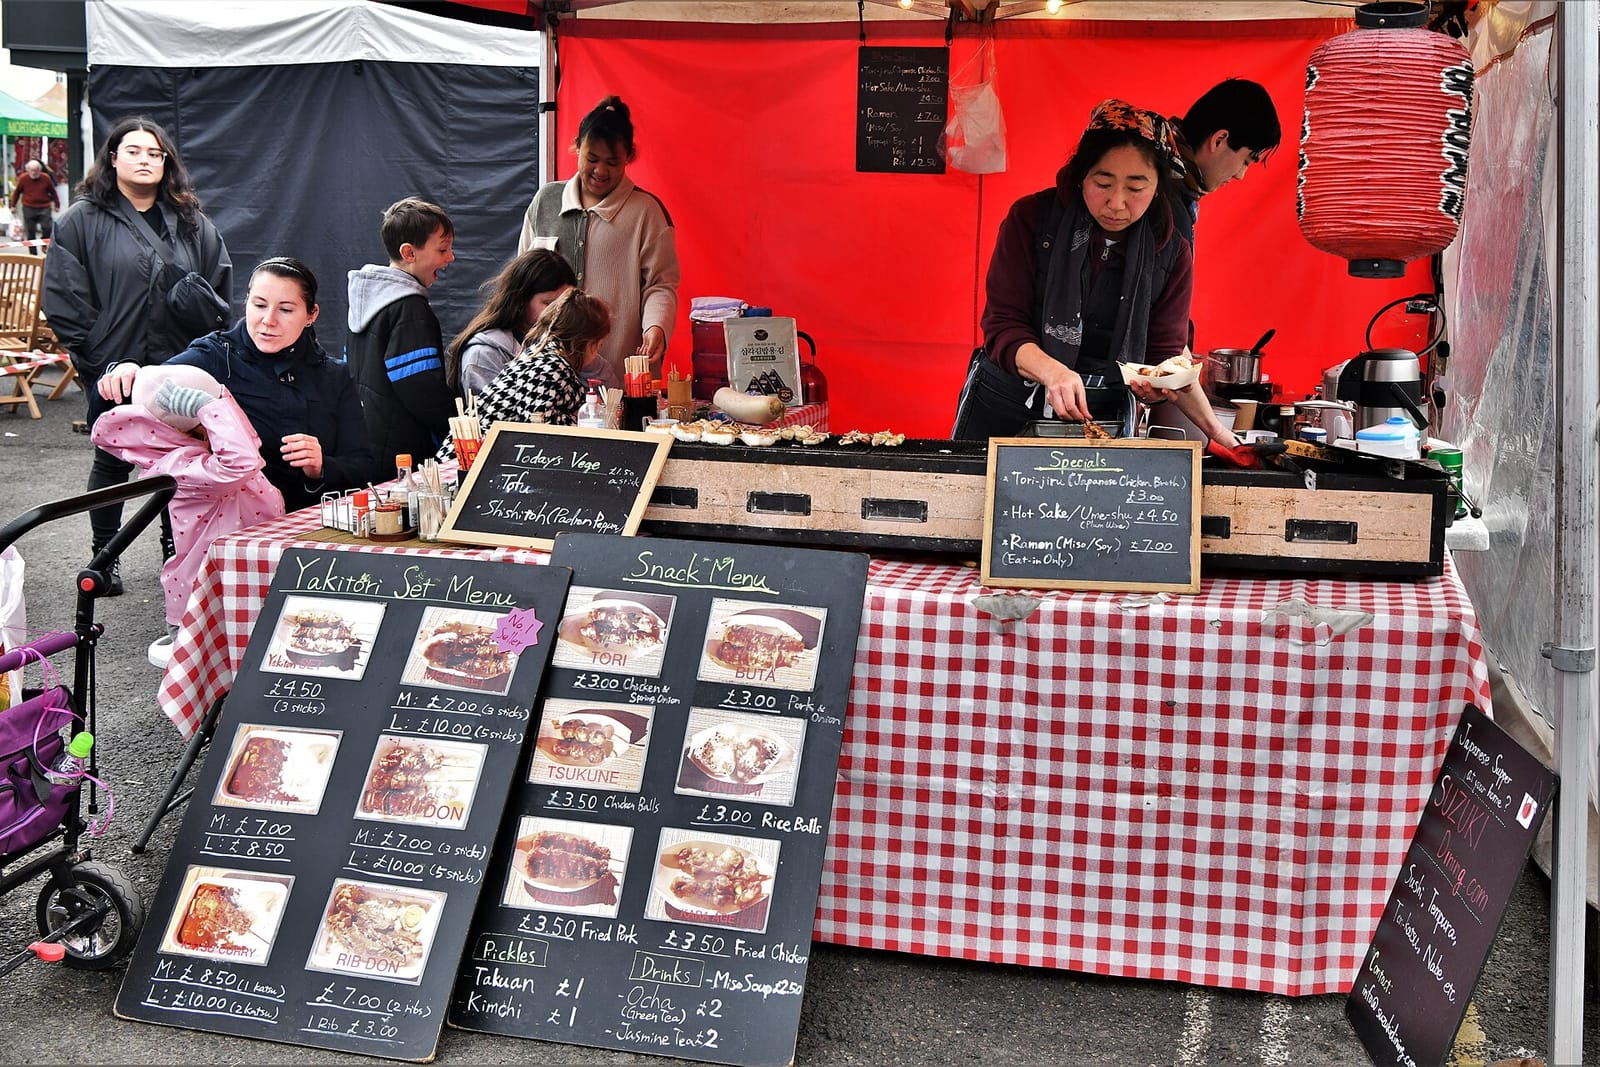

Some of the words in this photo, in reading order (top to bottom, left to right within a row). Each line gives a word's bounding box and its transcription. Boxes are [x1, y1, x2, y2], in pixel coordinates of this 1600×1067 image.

[8, 122, 49, 134] MORTGAGE
[570, 451, 601, 473] Vege
[608, 467, 635, 476] £1.50
[1050, 451, 1106, 474] Specials
[501, 471, 531, 494] Tofu
[1012, 471, 1065, 489] Tori-jiru
[1068, 472, 1117, 491] (Japanese
[1119, 474, 1153, 488] Chicken
[1154, 475, 1187, 489] Broth)
[1126, 489, 1165, 502] £3.00
[1012, 504, 1035, 518] Hot
[1137, 508, 1178, 522] £4.50
[1080, 521, 1104, 529] (Plum
[1105, 521, 1130, 530] Wine)
[1130, 539, 1173, 551] £7.00
[631, 551, 701, 584] Snack
[708, 556, 771, 590] Menu
[1002, 553, 1042, 566] (Eat-in
[1043, 552, 1074, 568] Only)
[295, 556, 384, 594] Yakitori
[393, 564, 438, 600] Set
[447, 574, 518, 606] Menu
[496, 627, 523, 648] Seller
[591, 650, 627, 667] TORI
[573, 673, 620, 691] £3.00
[622, 677, 662, 695] Chicken
[735, 668, 777, 683] BUTA
[269, 678, 322, 698] £4.50
[629, 692, 656, 705] Spring
[656, 694, 681, 705] Onion
[272, 701, 288, 714] (3
[291, 702, 326, 715] sticks)
[426, 694, 478, 712] £7.00
[480, 703, 494, 716] (3
[496, 704, 531, 721] sticks)
[723, 689, 777, 708] £3.00
[787, 694, 815, 712] Pork
[416, 719, 473, 737] £10.00
[811, 711, 842, 725] Onion
[1459, 722, 1491, 767] Japanese
[1491, 753, 1513, 790] Supper
[547, 765, 620, 785] TSUKUNE
[549, 790, 598, 810] £3.50
[603, 794, 635, 811] Chicken
[638, 796, 661, 814] Balls
[1434, 774, 1490, 851] SUZUKI
[235, 817, 292, 837] £7.00
[697, 804, 752, 824] £3.00
[761, 813, 792, 833] Rice
[793, 816, 823, 836] Balls
[229, 837, 285, 857] £8.50
[382, 832, 433, 851] £7.00
[437, 841, 451, 855] (3
[453, 843, 488, 861] sticks)
[373, 856, 425, 876] £10.00
[517, 912, 577, 937] £3.50
[580, 918, 612, 942] Fried
[616, 923, 638, 945] Pork
[482, 940, 536, 964] Pickles
[665, 929, 725, 953] £3.50
[734, 938, 766, 960] Fried
[770, 944, 808, 965] Chicken
[641, 955, 692, 984] Drinks
[1369, 950, 1393, 995] Contact:
[1422, 943, 1444, 981] Nabe
[179, 963, 237, 987] £8.50
[237, 979, 250, 993] (1
[474, 966, 536, 994] Takuan
[556, 977, 586, 1000] £1
[771, 978, 803, 995] £2.50
[171, 990, 227, 1010] £10.00
[315, 982, 382, 1010] £7.00
[386, 1000, 402, 1014] (2
[403, 998, 432, 1018] ribs)
[466, 991, 523, 1020] Kimchi
[547, 1006, 578, 1027] £1
[626, 984, 676, 1010] Ocha
[695, 998, 723, 1018] £2
[620, 1004, 658, 1023] (Green
[659, 1007, 688, 1025] Tea)
[317, 1014, 339, 1030] Rib
[346, 1016, 399, 1038] £3.00
[615, 1021, 671, 1046] Jasmine
[673, 1027, 696, 1047] Tea
[695, 1028, 719, 1048] £2
